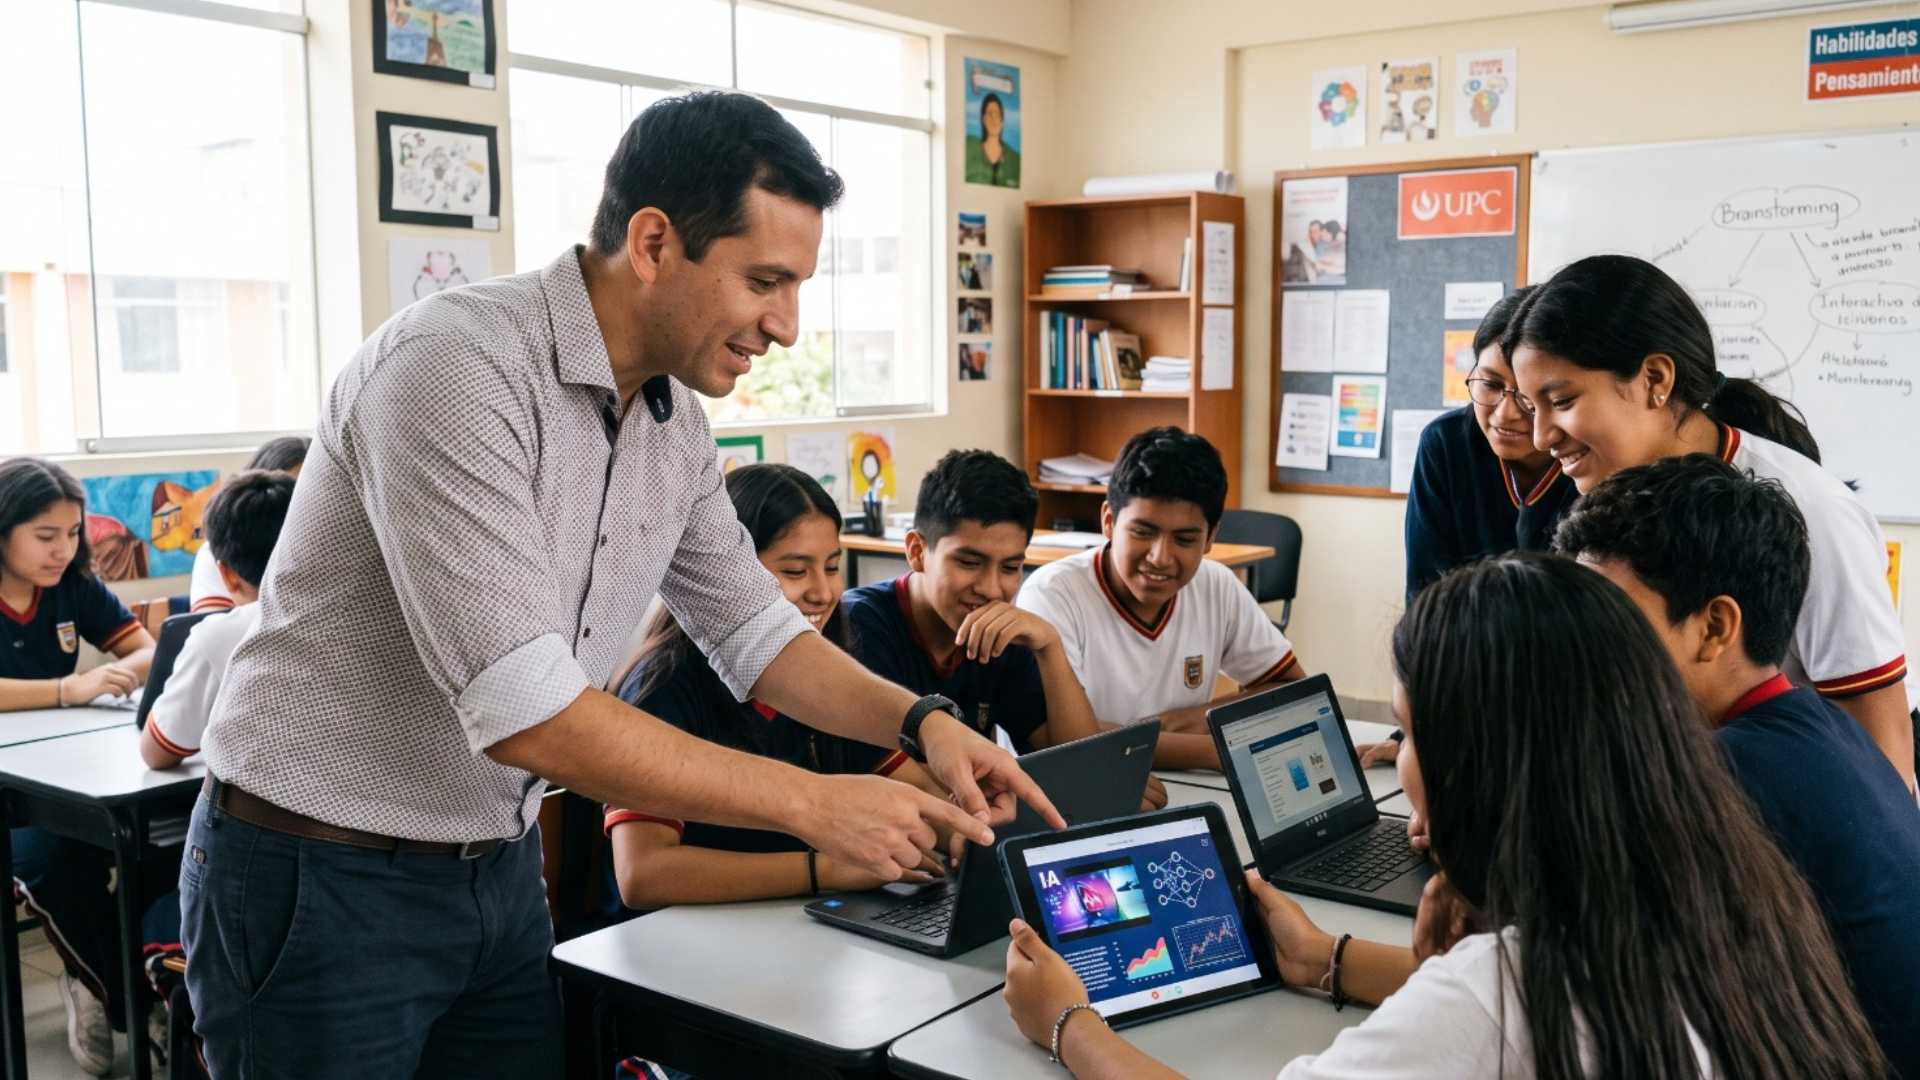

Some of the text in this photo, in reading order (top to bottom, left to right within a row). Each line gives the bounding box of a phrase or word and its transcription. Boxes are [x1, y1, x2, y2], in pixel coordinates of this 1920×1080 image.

[1815, 28, 1918, 55] Habilidades
[1815, 64, 1920, 92] Pensamient
[1444, 190, 1502, 217] UPC
[1721, 197, 1840, 230] Brainstorming
[1039, 870, 1062, 889] IA
